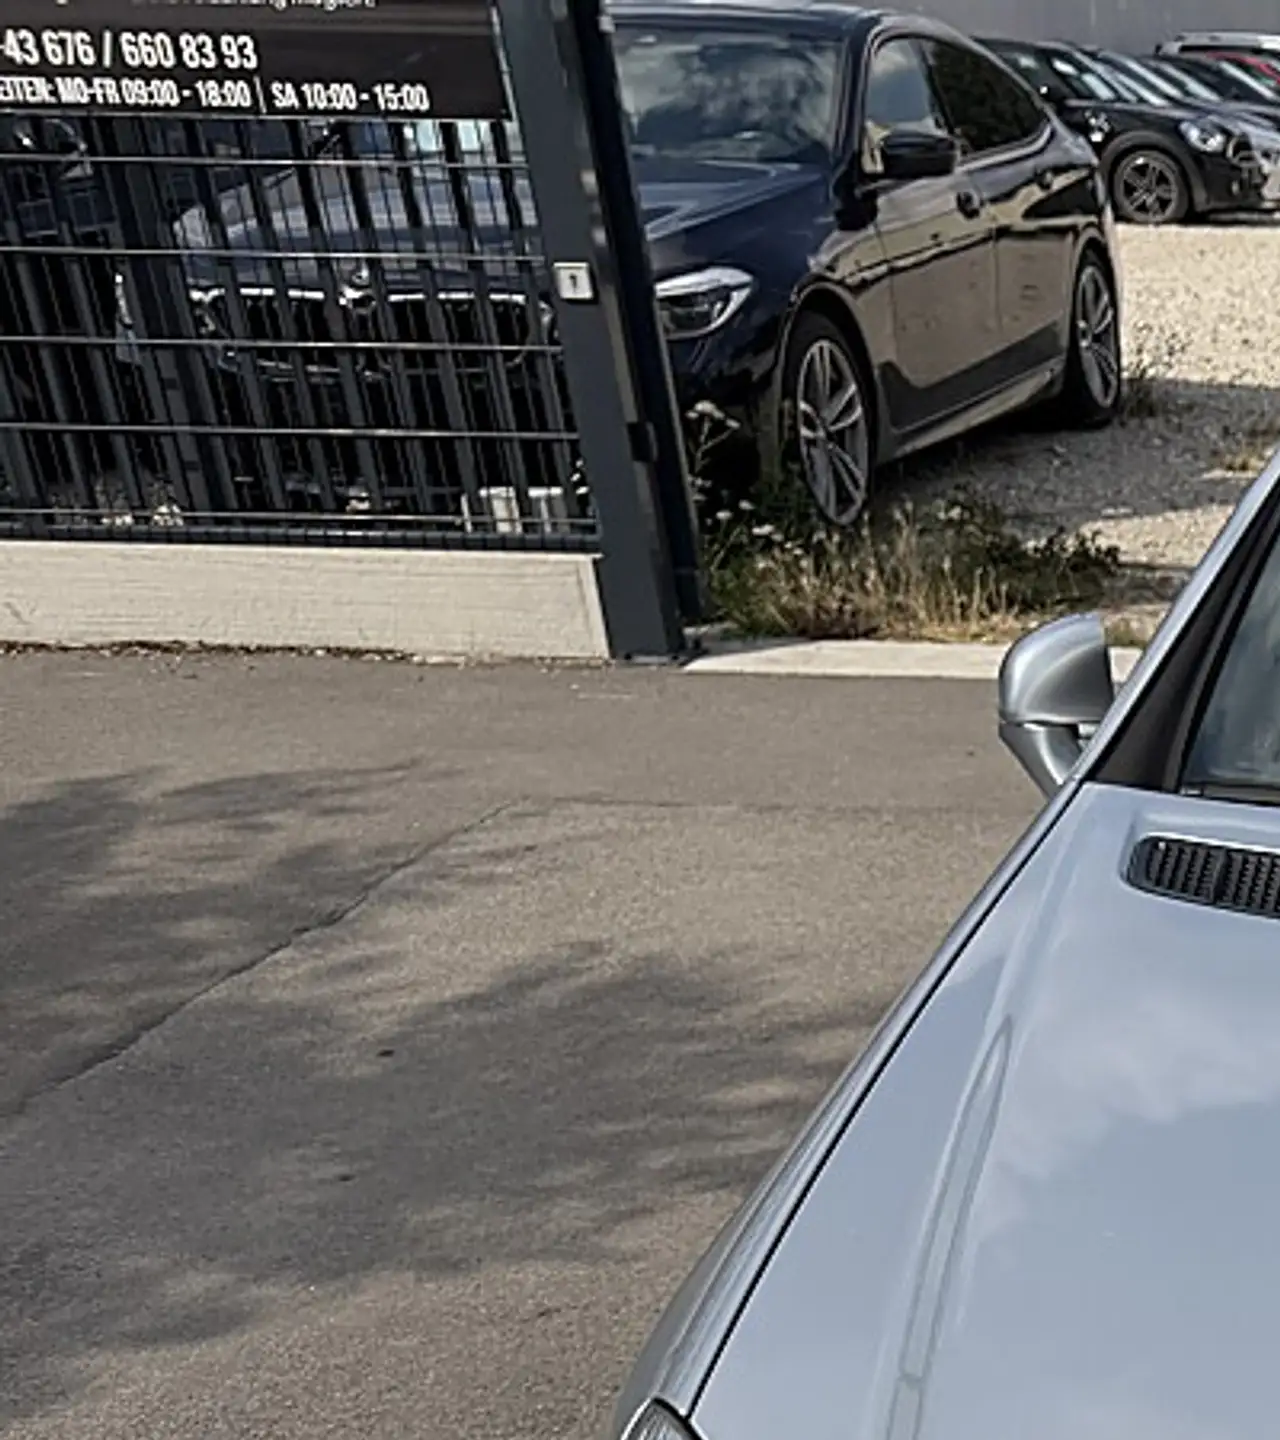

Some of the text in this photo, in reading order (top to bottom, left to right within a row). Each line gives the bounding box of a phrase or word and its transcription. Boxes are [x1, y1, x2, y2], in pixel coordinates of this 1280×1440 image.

[41, 29, 96, 66] 676
[103, 30, 112, 68] /
[119, 31, 176, 68] 660
[179, 33, 216, 69] 83
[220, 35, 258, 69] 93
[54, 77, 120, 104] MO-FR
[120, 77, 180, 107] 09:00
[195, 80, 251, 107] 18:00
[271, 82, 299, 109] SA
[301, 83, 357, 110] 10:00
[373, 84, 430, 111] 15:00
